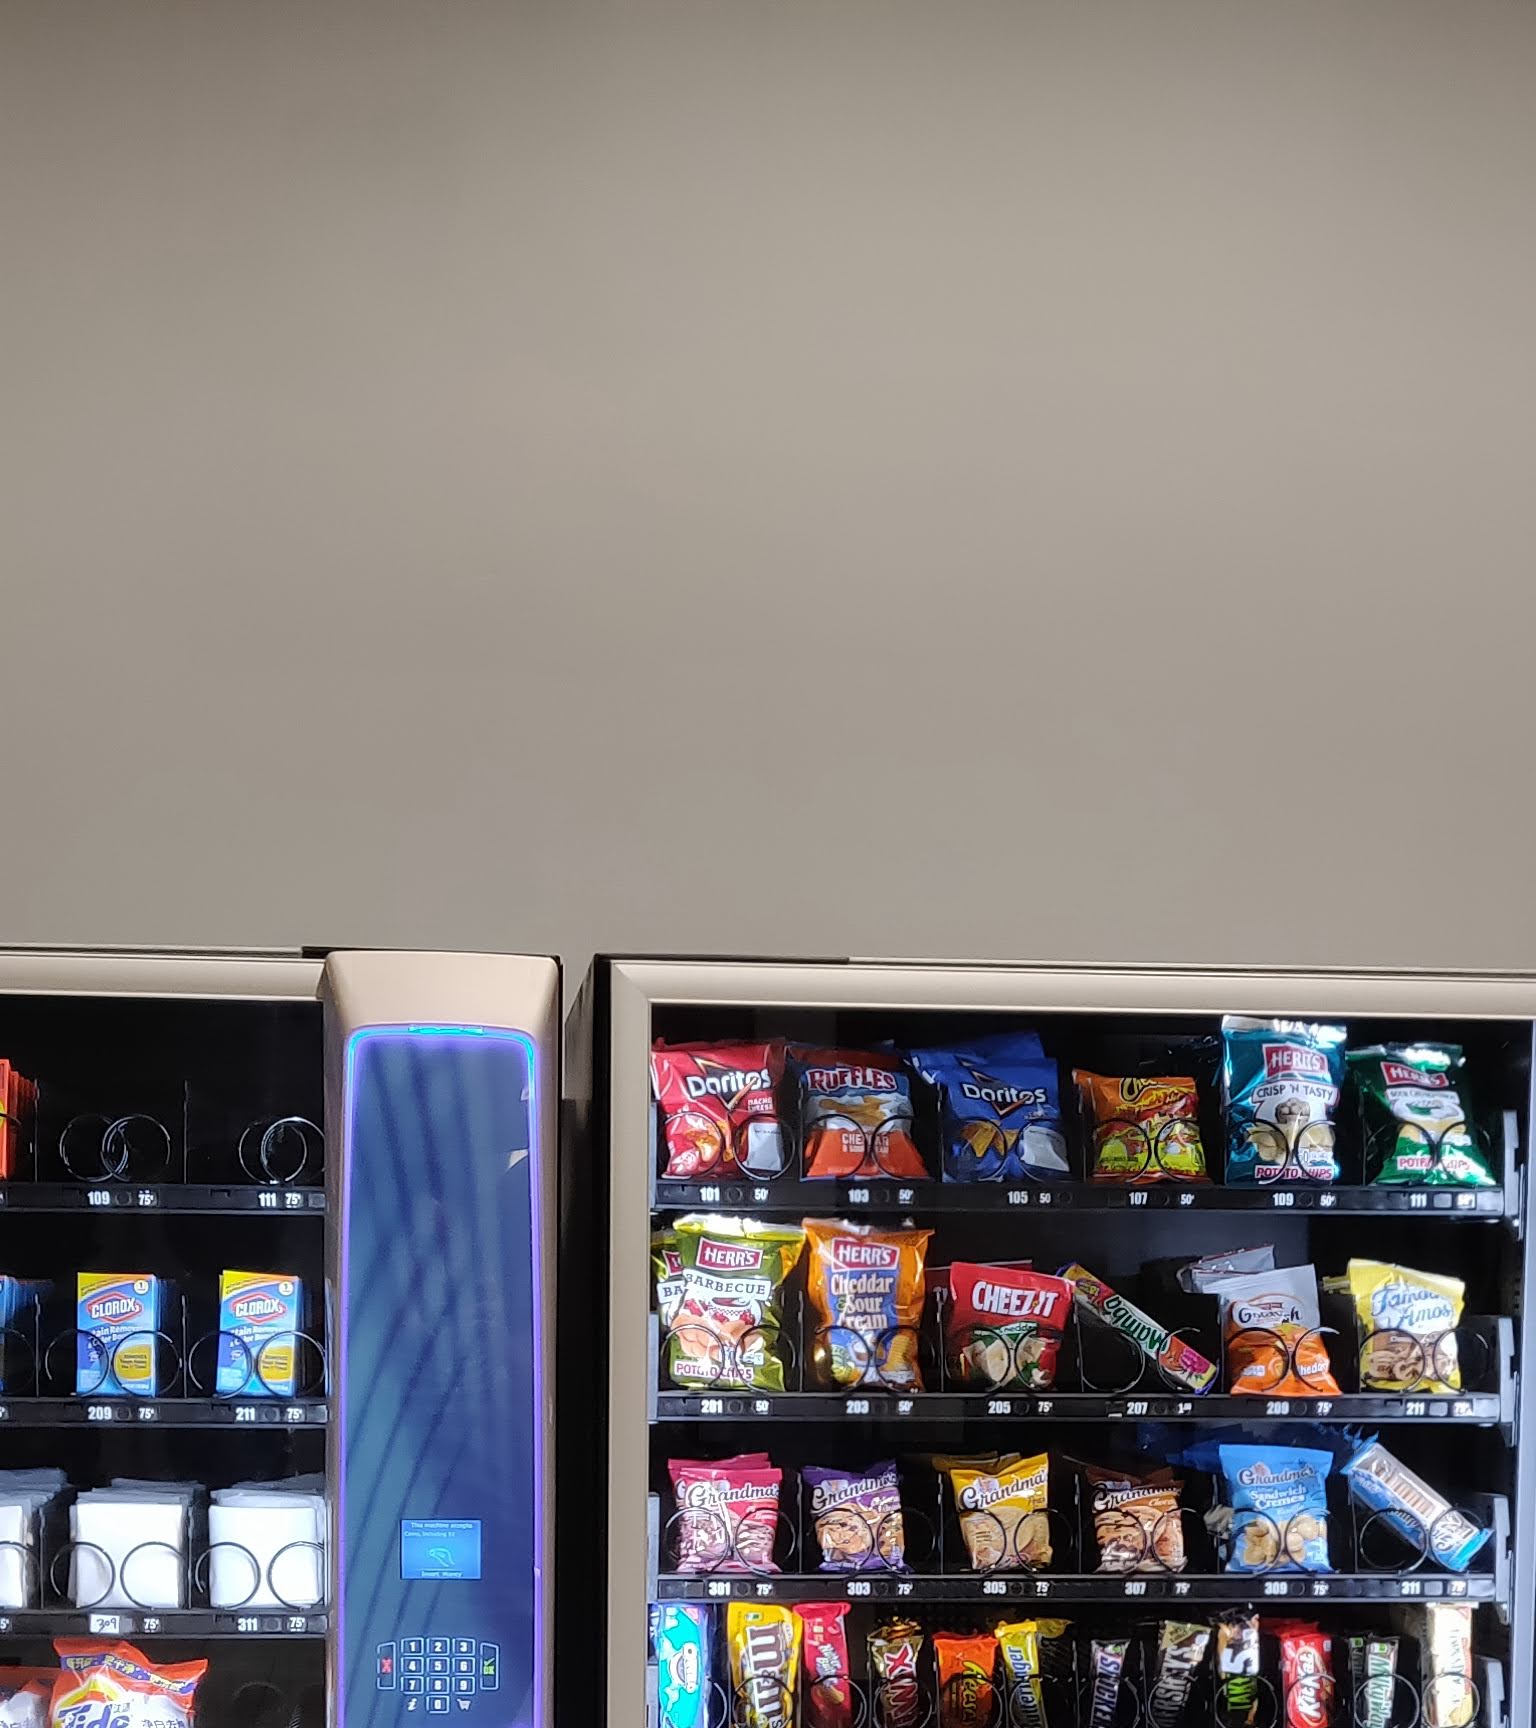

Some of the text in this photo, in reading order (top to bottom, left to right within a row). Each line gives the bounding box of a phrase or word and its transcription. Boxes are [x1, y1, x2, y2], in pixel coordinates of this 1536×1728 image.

[687, 1068, 772, 1097] Doritos
[806, 1066, 898, 1092] RUFFLES
[964, 1083, 1046, 1104] Doritos
[1256, 1085, 1285, 1100] CRISP
[1303, 1084, 1334, 1101] TASTY
[87, 1190, 111, 1206] 109
[258, 1192, 277, 1208] 111
[699, 1186, 720, 1203] 101
[1409, 1193, 1427, 1208] 111
[704, 1245, 762, 1268] HERR'S
[838, 1243, 895, 1268] HERR'S
[684, 1272, 767, 1297] BARBECUE
[830, 1272, 894, 1296] Cheddar
[846, 1294, 882, 1313] Sour
[1104, 1294, 1168, 1353] Mamba
[1390, 1303, 1453, 1331] Amos
[1405, 1401, 1425, 1416] 211
[687, 1483, 779, 1508] Grandma's
[959, 1468, 1048, 1508] Grandma's
[1250, 1485, 1307, 1500] Sandwich
[1255, 1496, 1305, 1510] Cremes
[708, 1581, 731, 1596] 301
[983, 1580, 1007, 1595] 305
